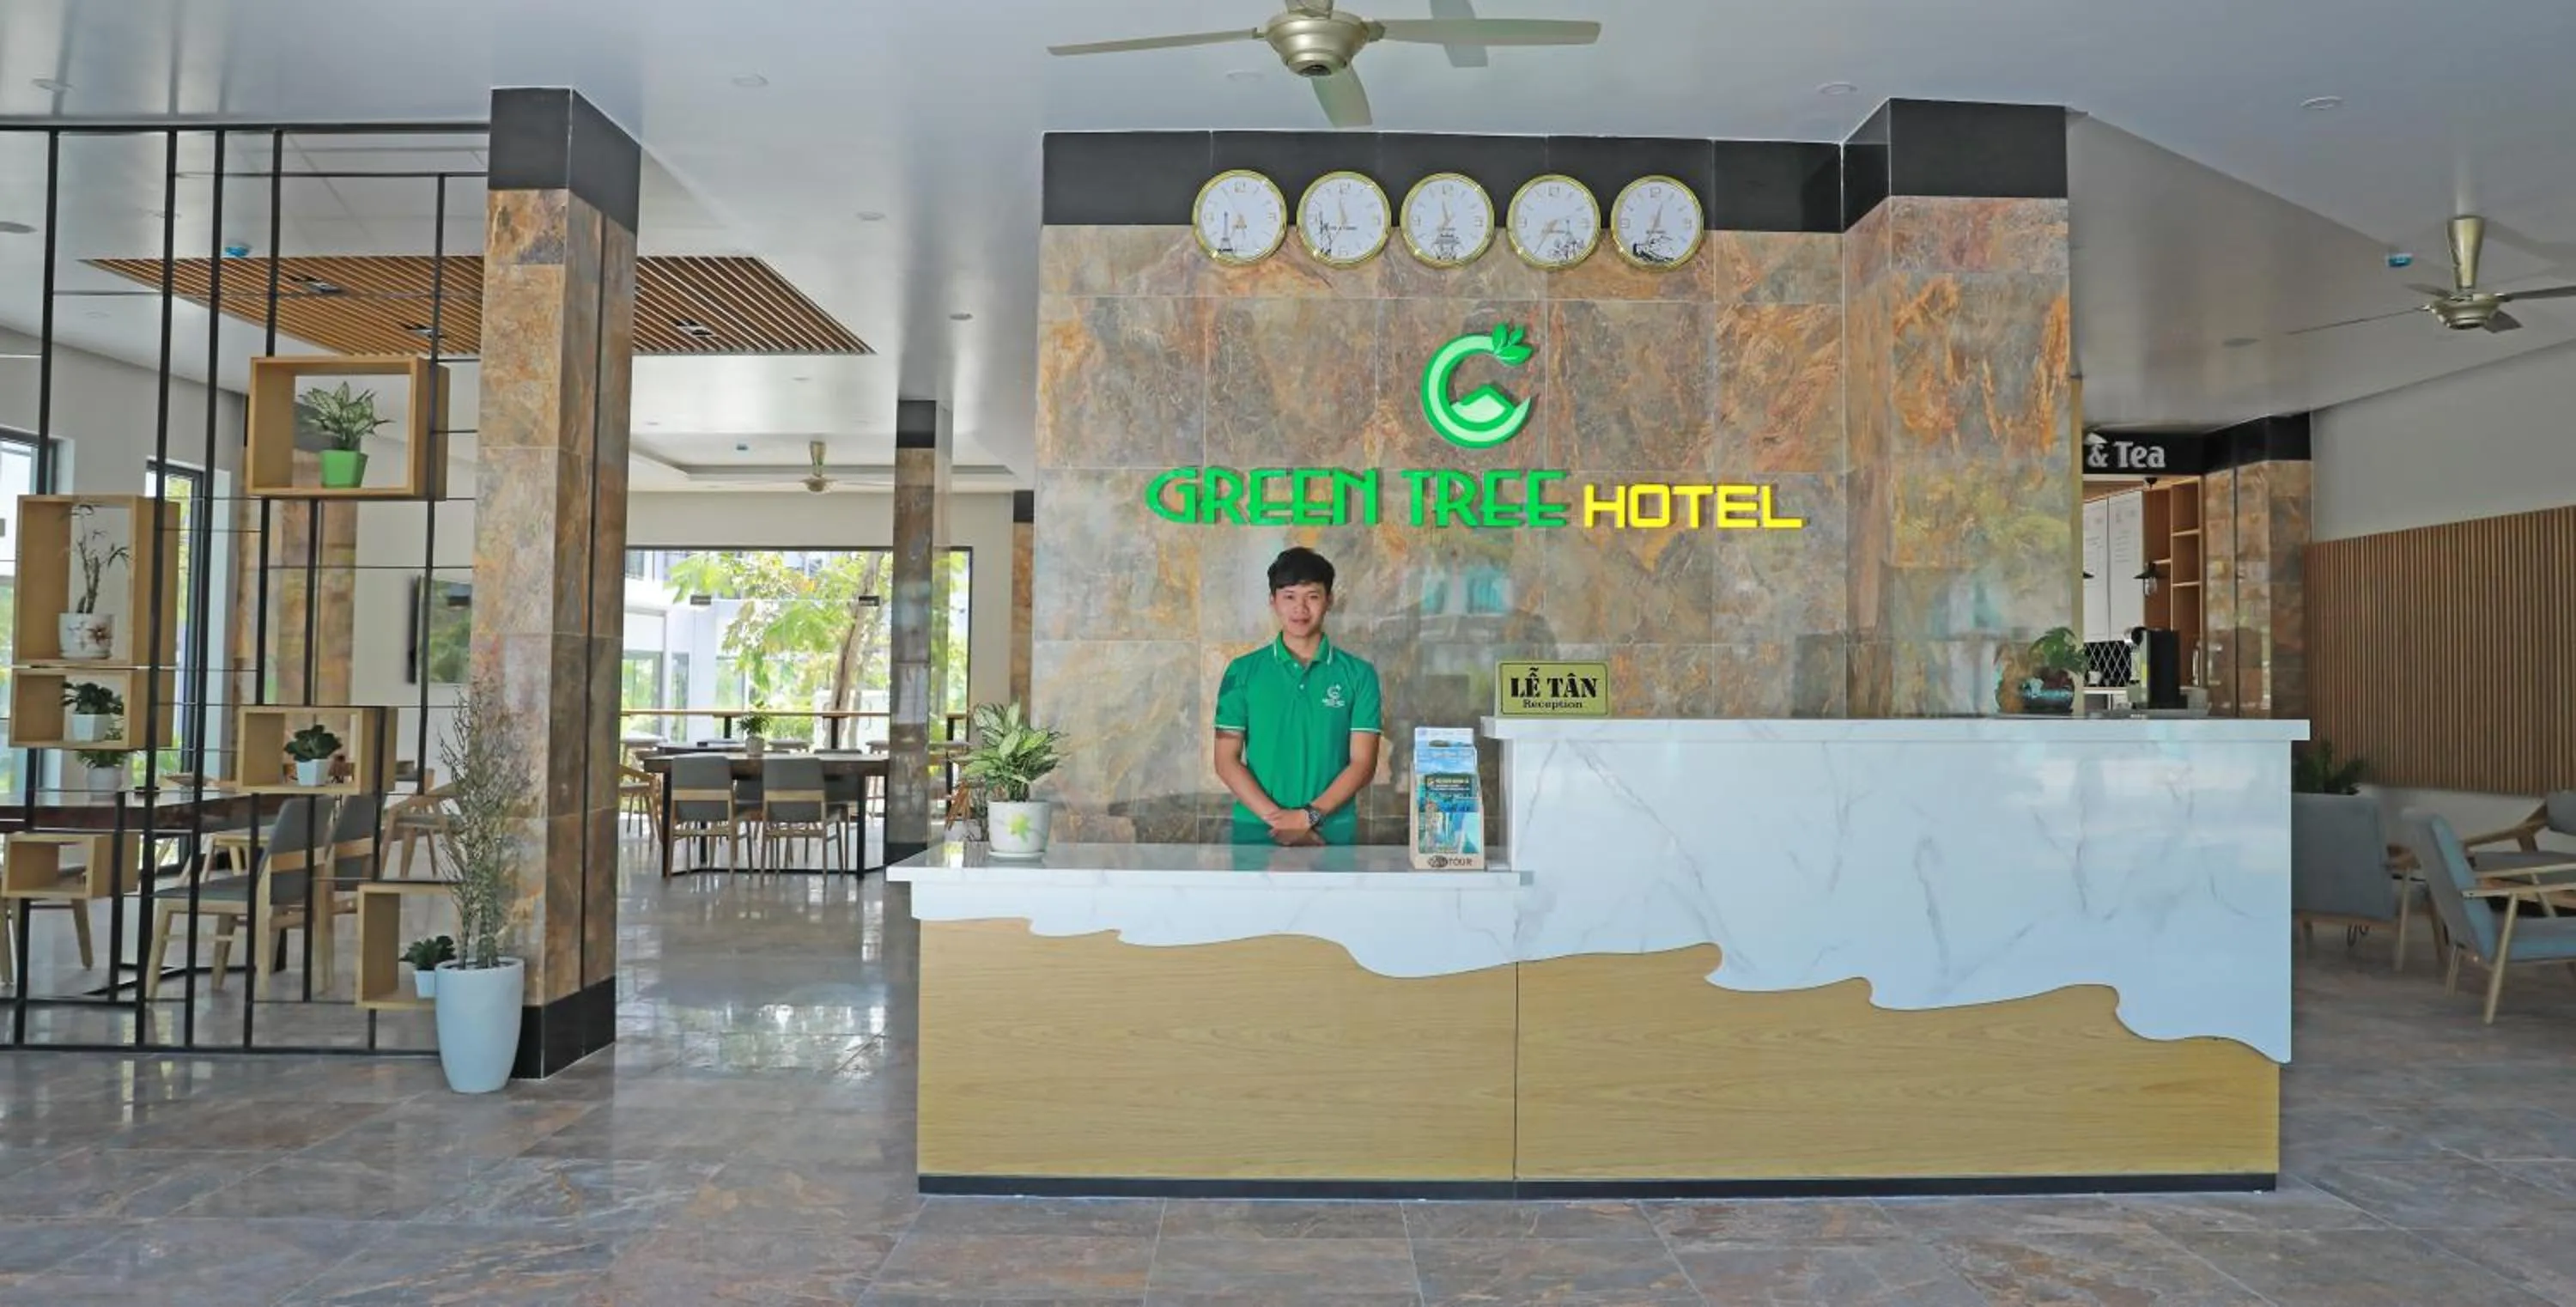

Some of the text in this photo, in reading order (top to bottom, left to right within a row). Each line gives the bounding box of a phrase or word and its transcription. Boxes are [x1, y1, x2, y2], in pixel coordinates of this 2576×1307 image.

[2087, 441, 2166, 468] & Tea
[1145, 466, 1802, 529] GREEN TREE HOTEL
[1510, 667, 1599, 698] LỄ TÂN
[1523, 698, 1583, 710] Reception
